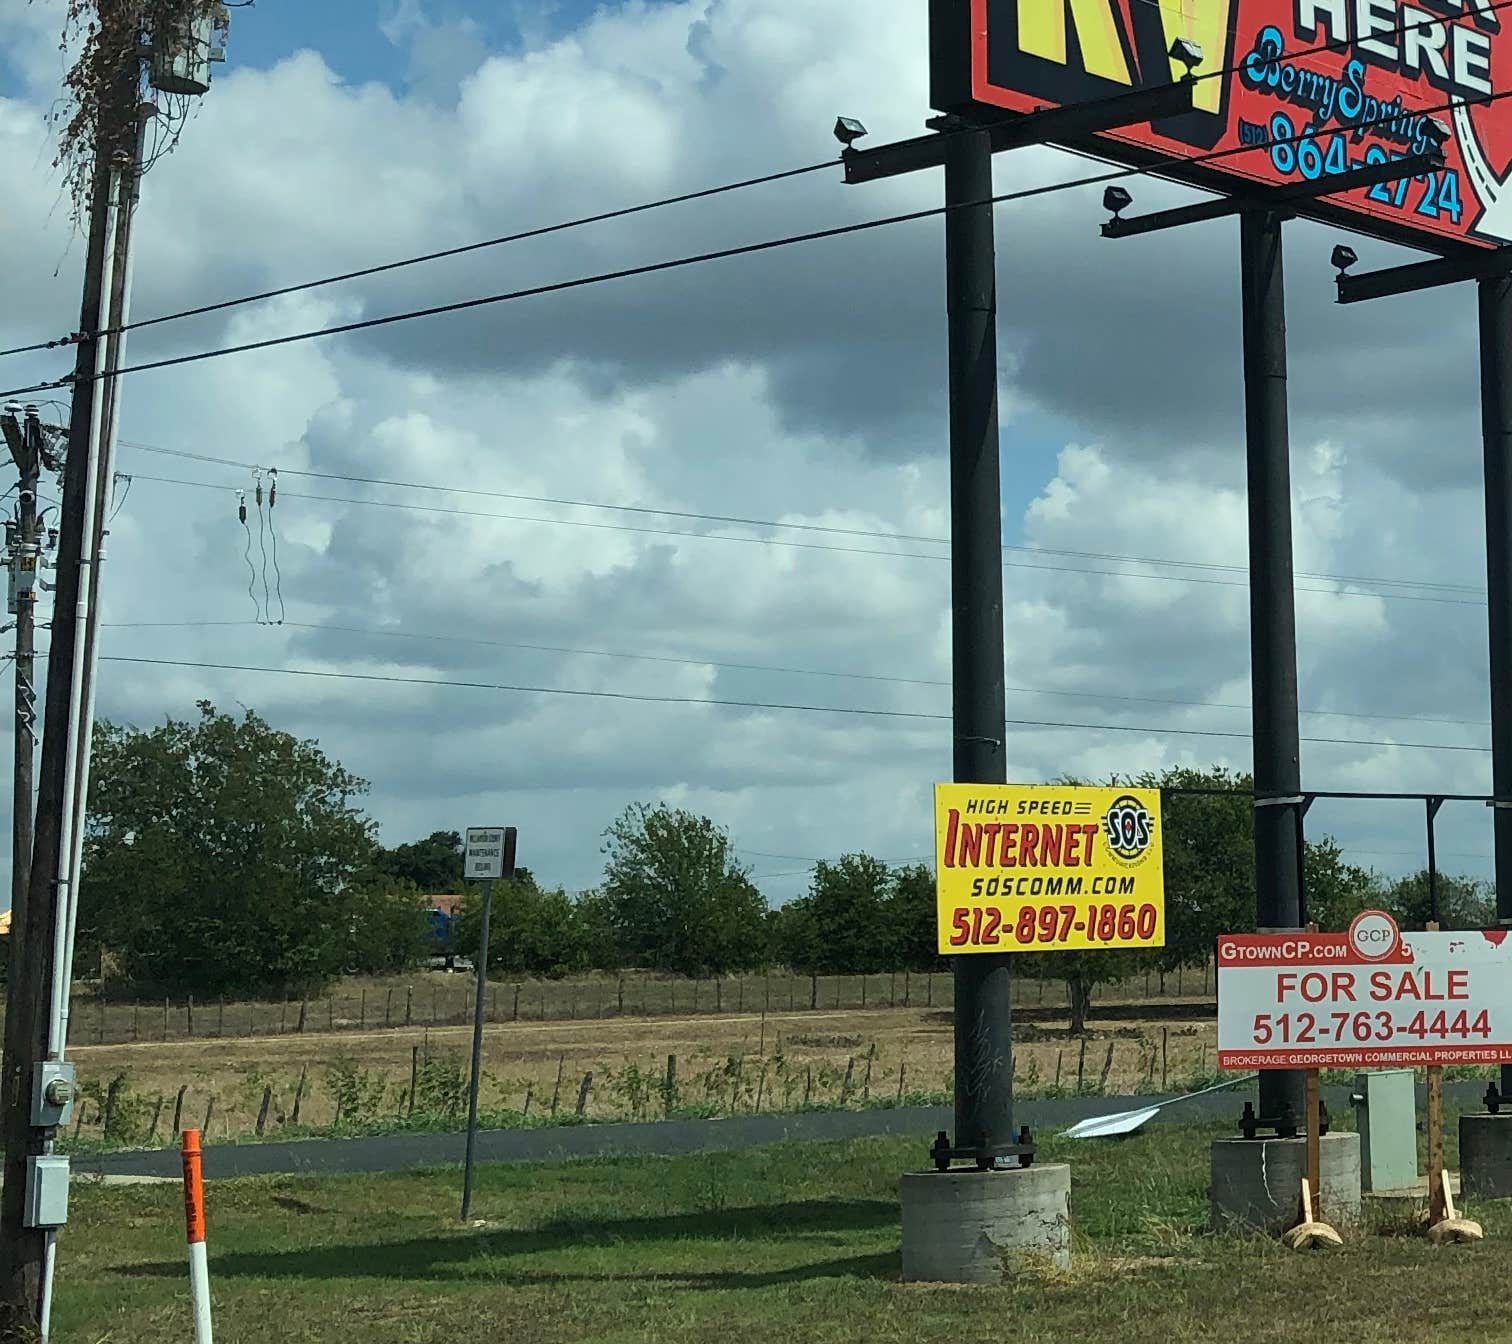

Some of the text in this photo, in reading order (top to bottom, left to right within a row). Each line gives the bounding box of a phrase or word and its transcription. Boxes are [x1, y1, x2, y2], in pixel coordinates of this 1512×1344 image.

[1246, 25, 1438, 156] Berry Spring
[966, 799, 1075, 815] HIGH SPEED
[943, 808, 1100, 869] INTERNET
[1107, 808, 1150, 850] SOS
[970, 876, 1136, 897] SOSCOMM.COM
[949, 903, 1157, 947] 512-897-1860
[1357, 929, 1391, 943] GCP
[1276, 969, 1470, 1004] FOR SALE
[1252, 1008, 1493, 1045] 512-763-4444
[1289, 1053, 1363, 1065] GEORGETOWN
[1365, 1051, 1433, 1062] COMMERCIAL
[1434, 1050, 1498, 1061] PROPERTIES
